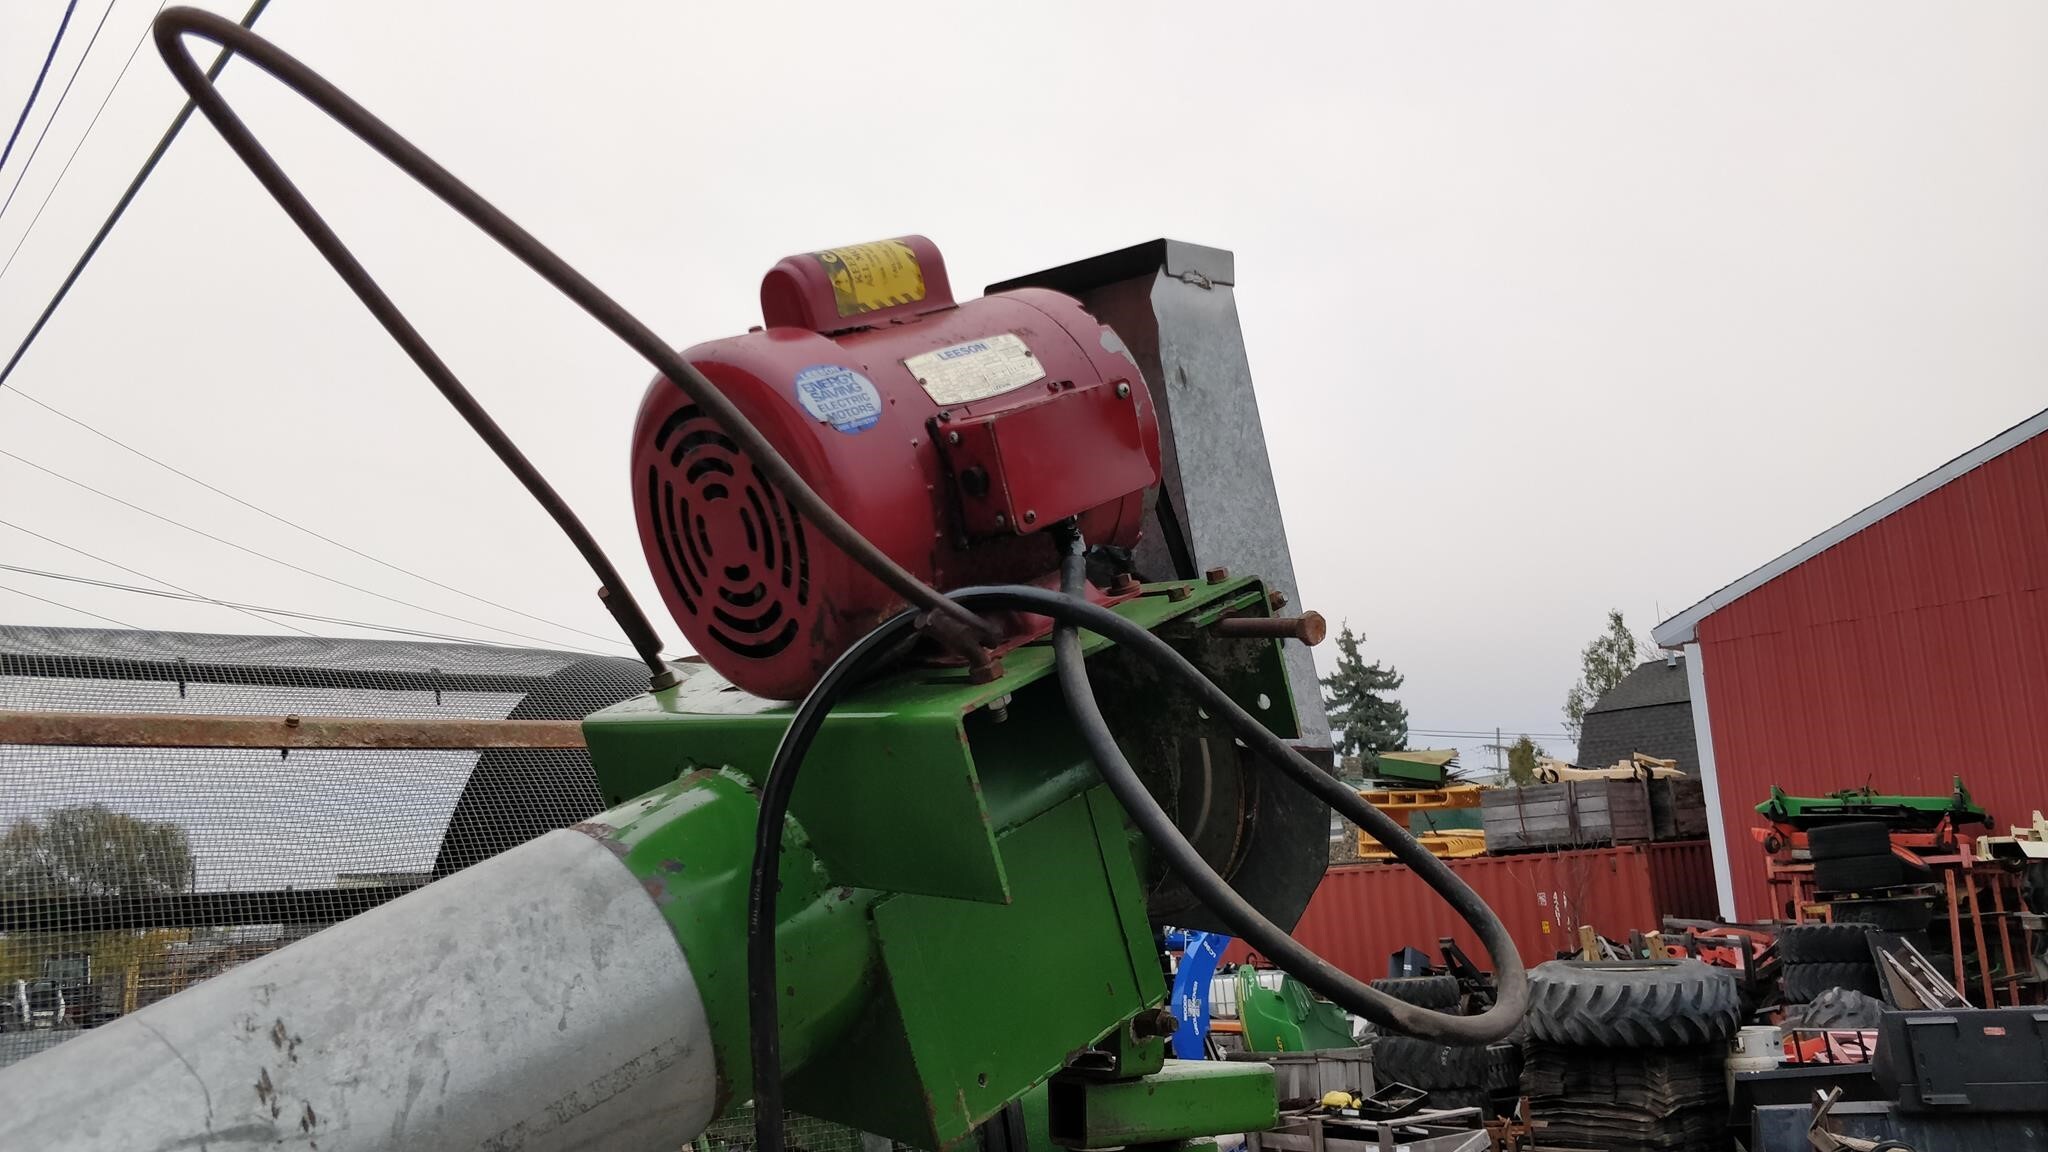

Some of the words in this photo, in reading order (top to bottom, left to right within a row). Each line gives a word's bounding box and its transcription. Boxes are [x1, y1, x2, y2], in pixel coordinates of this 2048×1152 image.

[936, 343, 988, 361] LEESON
[801, 373, 857, 393] ENERGY
[811, 382, 863, 403] SAVING
[817, 392, 871, 413] ELECTRIC
[826, 402, 876, 421] MOTORS
